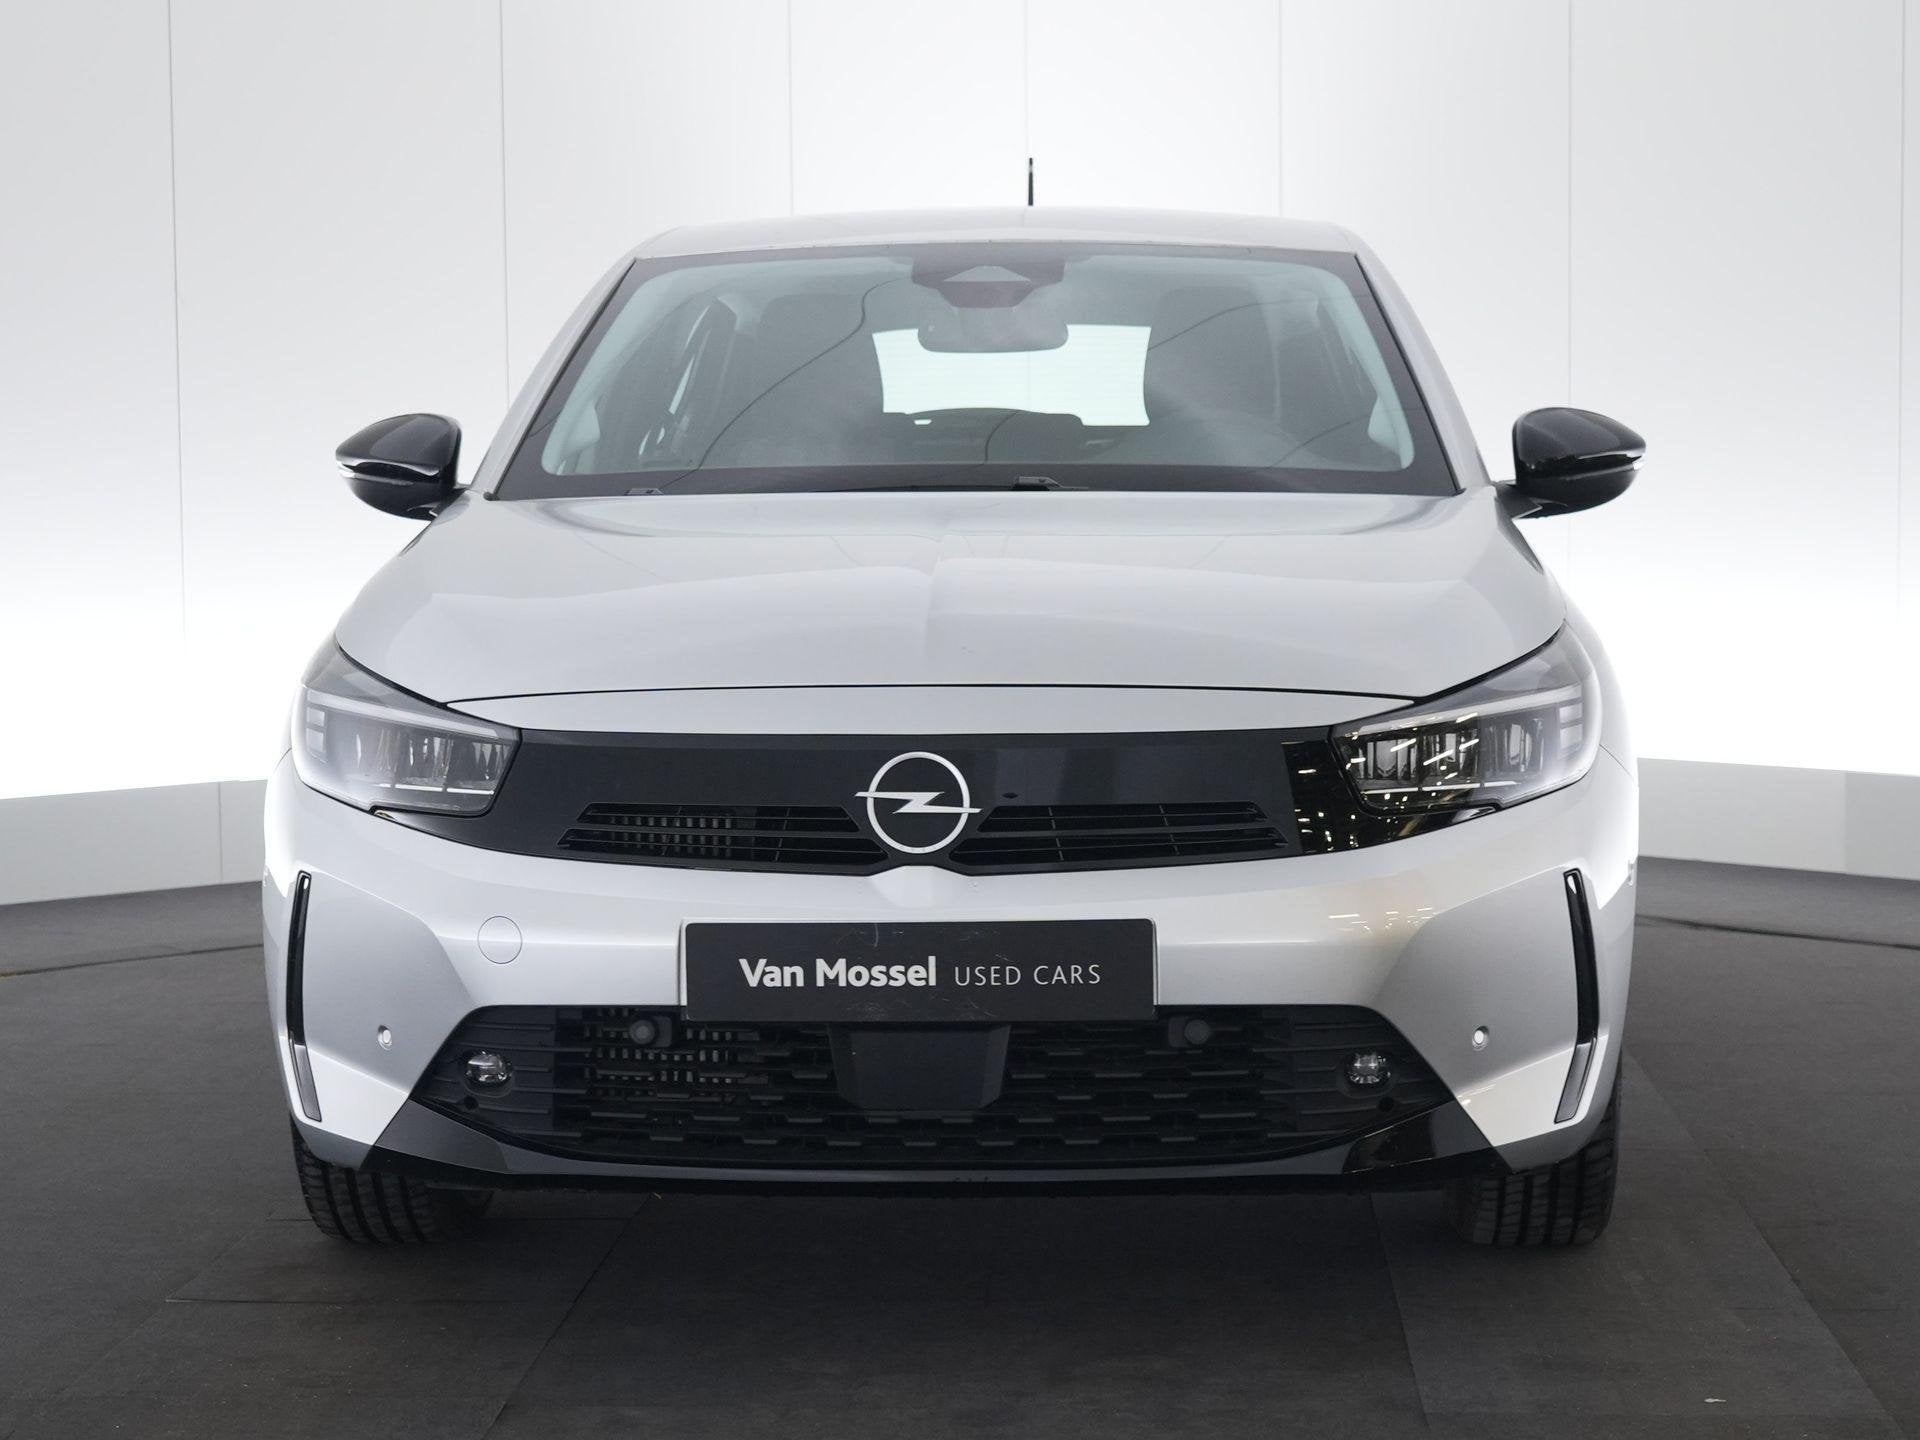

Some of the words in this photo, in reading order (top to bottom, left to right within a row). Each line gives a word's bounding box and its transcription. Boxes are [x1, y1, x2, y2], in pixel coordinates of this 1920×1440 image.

[738, 958, 805, 988] Van
[815, 955, 937, 988] Mossel
[954, 965, 1021, 987] USED
[1033, 964, 1101, 986] CARS
